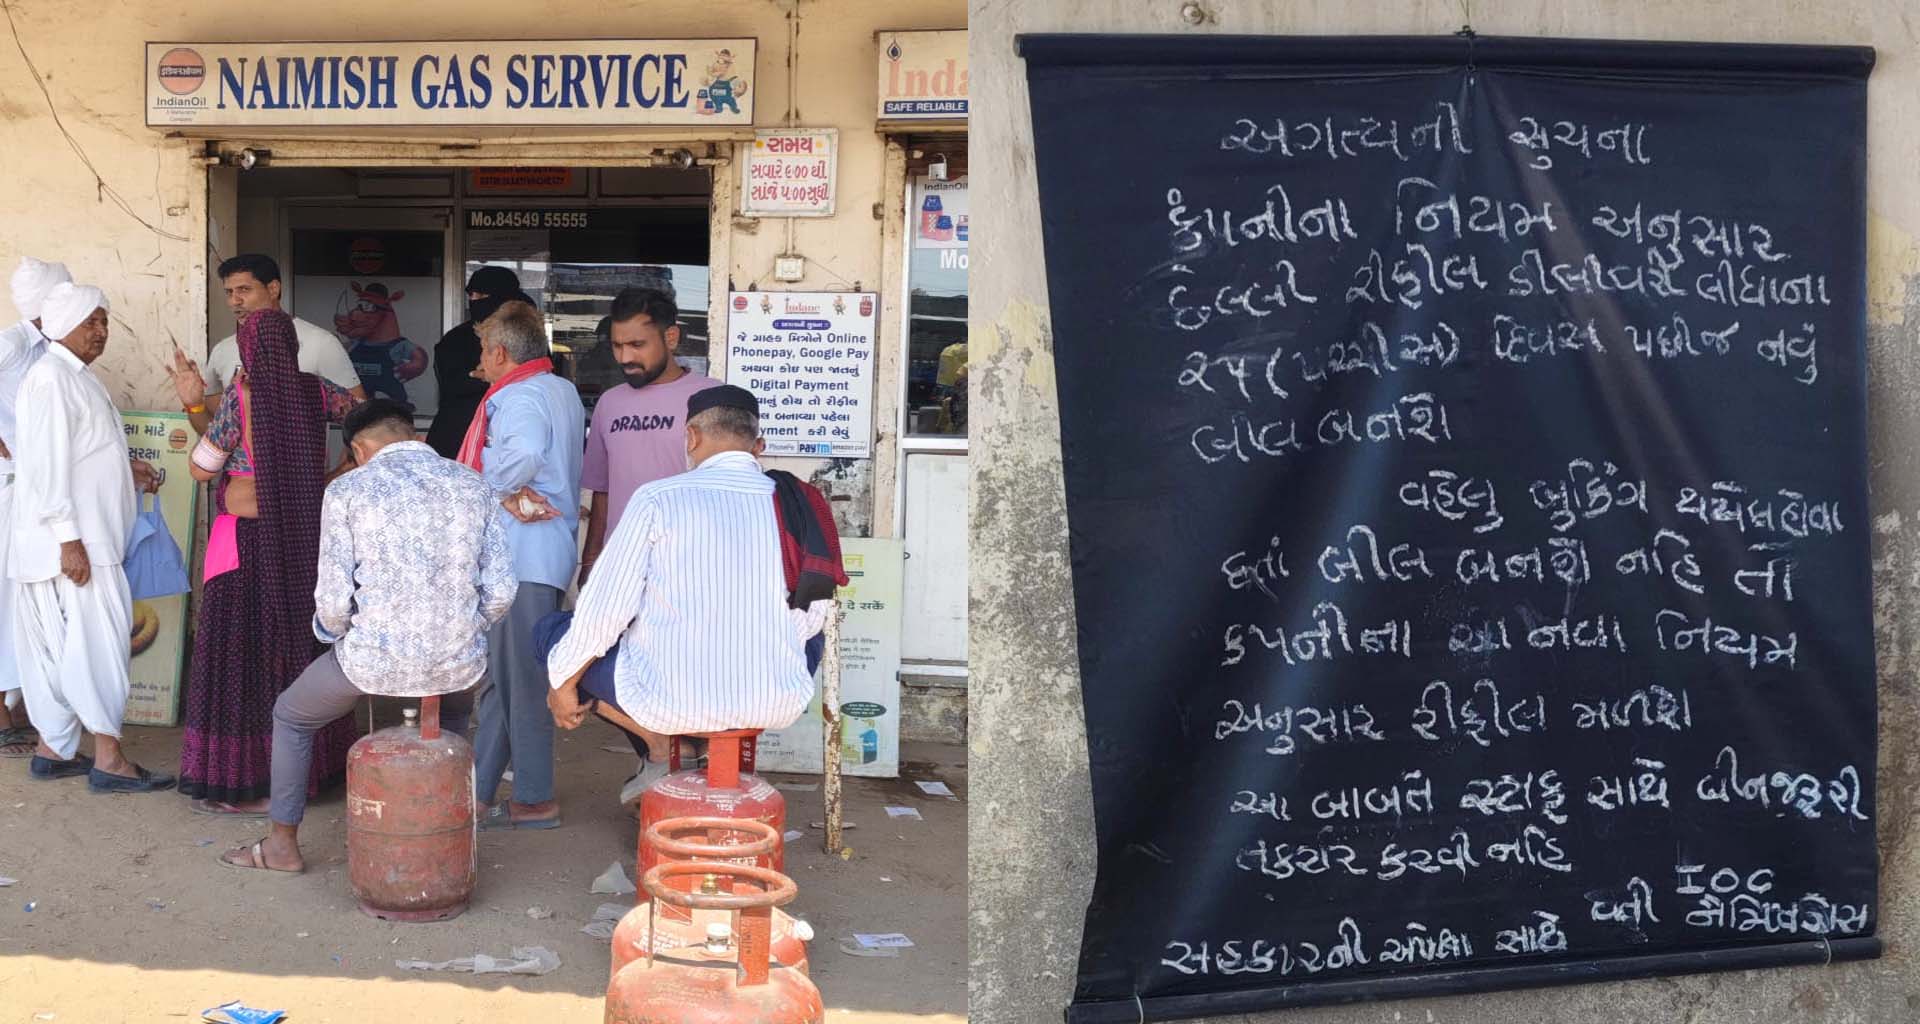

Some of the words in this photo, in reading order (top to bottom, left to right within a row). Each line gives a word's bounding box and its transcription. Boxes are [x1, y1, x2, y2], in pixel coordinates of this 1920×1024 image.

[217, 55, 397, 110] NAIMISH
[410, 54, 492, 108] GAS
[506, 53, 690, 108] SERVICE
[157, 97, 207, 106] IndianOil
[886, 103, 914, 112] SAFE
[916, 102, 965, 112] RELIABLE
[1220, 101, 1472, 161] અગત્યની
[766, 137, 813, 154] સમય
[751, 159, 782, 179] સવારે
[1396, 176, 1557, 242] નિયમ
[471, 211, 539, 226] Mo.84549
[543, 212, 588, 228] 55555
[737, 332, 747, 342] જે
[827, 332, 867, 344] Online
[799, 347, 843, 360] Google
[847, 348, 870, 360] Pay
[741, 365, 774, 373] અથવા
[804, 366, 824, 374] પણ
[750, 379, 790, 392] Digital
[794, 380, 849, 392] Payment
[808, 396, 821, 406] તો
[821, 411, 850, 422] પહેલા
[144, 421, 165, 437] માટે
[610, 414, 675, 434] DRAGON
[760, 427, 798, 436] yment
[807, 426, 827, 436] કરી
